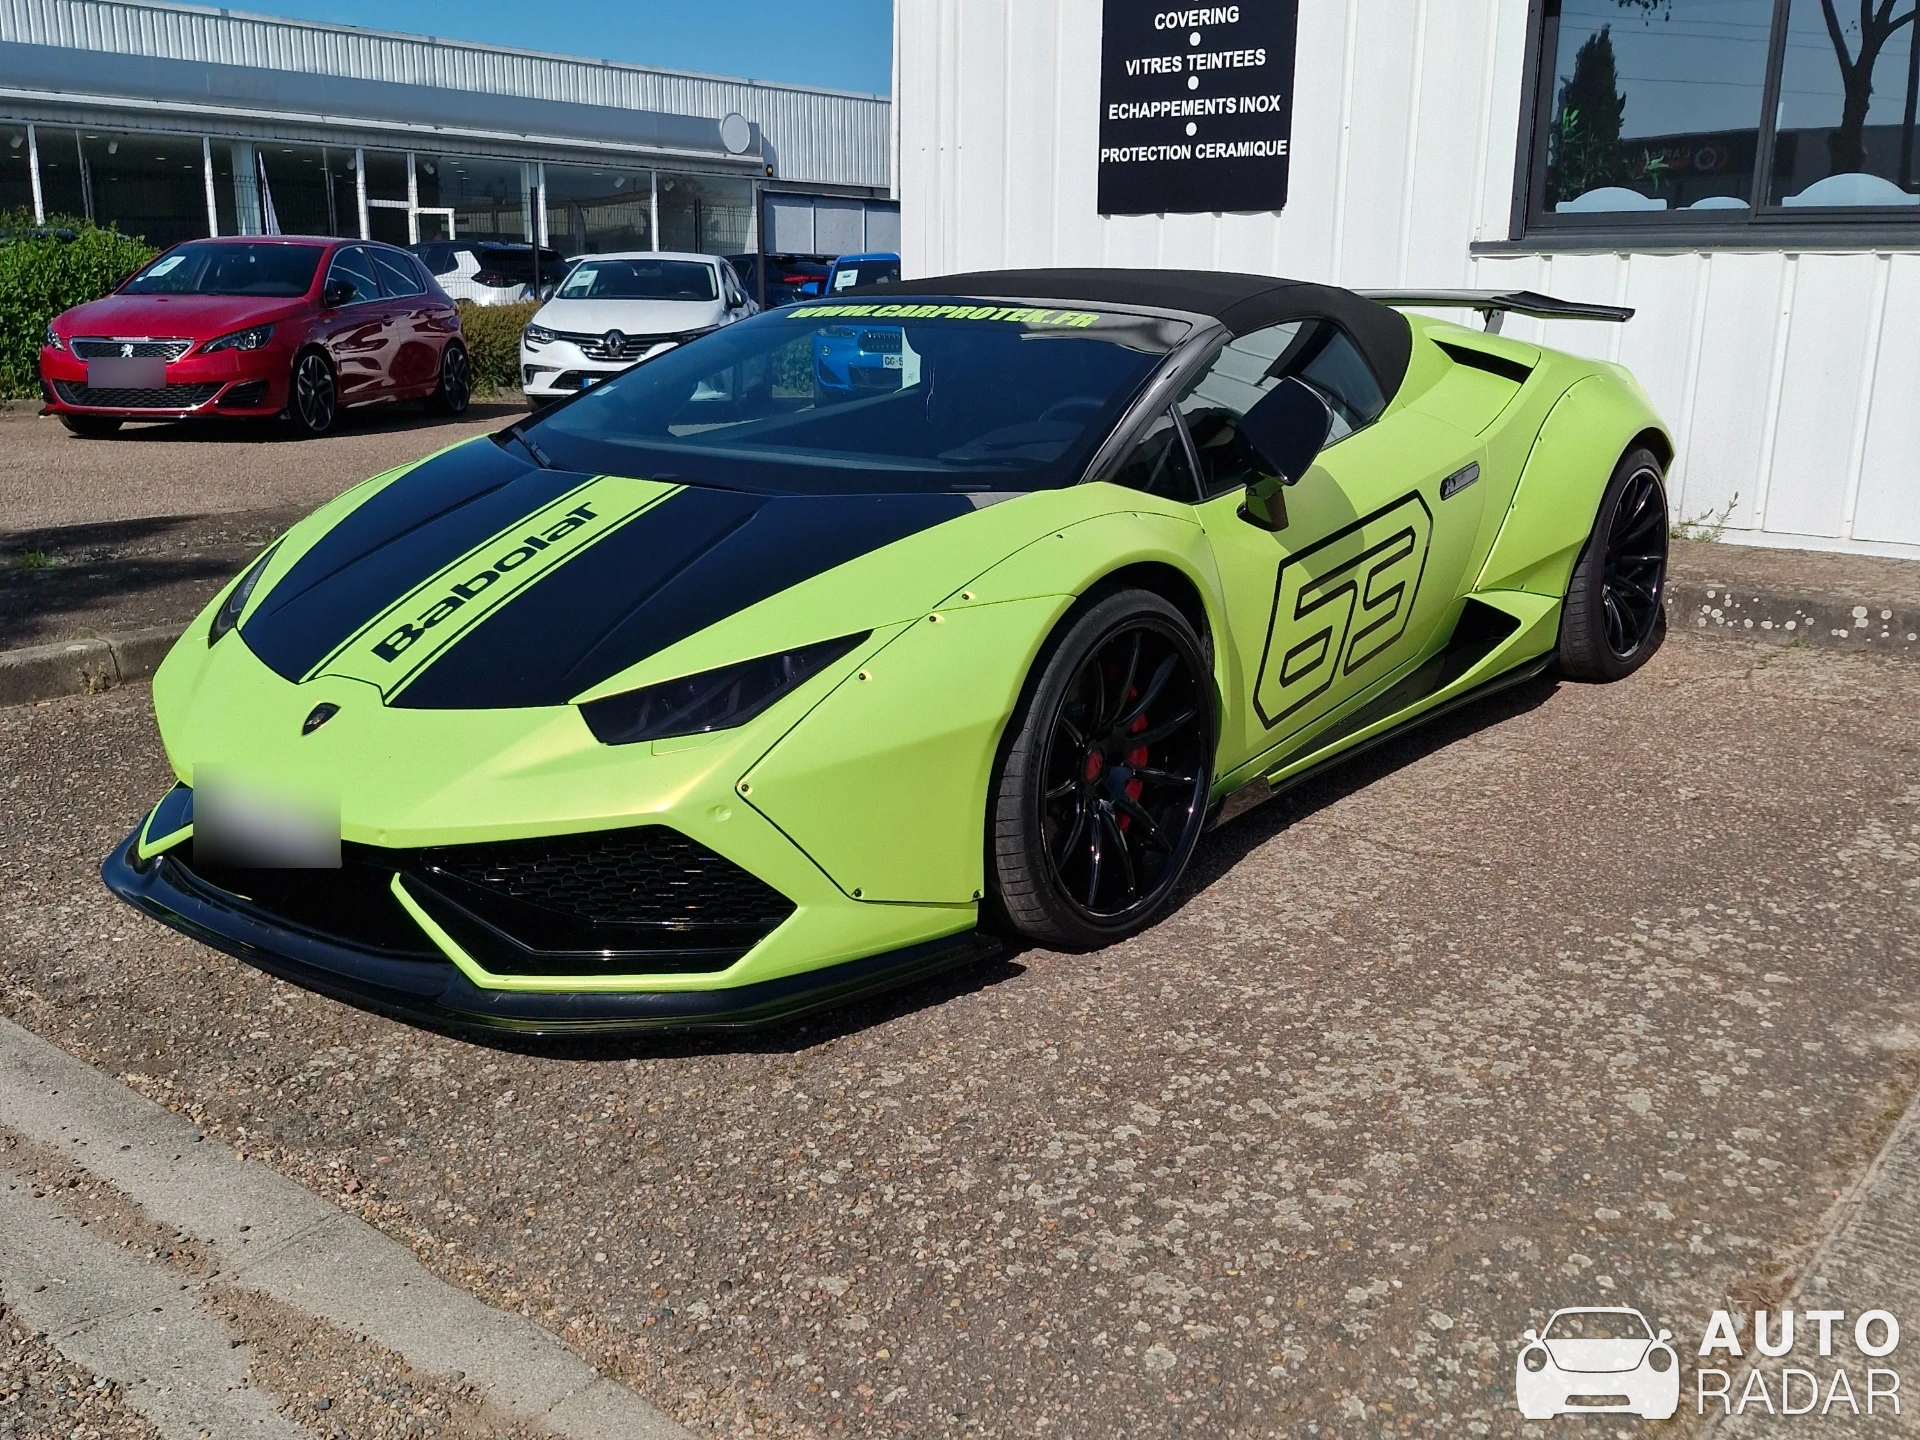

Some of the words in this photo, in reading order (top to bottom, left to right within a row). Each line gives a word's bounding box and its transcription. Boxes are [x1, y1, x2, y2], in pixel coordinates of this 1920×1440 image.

[1154, 5, 1240, 30] COVERING
[1126, 55, 1182, 76] VITRES
[1187, 48, 1266, 71] TEINTEES
[1108, 97, 1236, 119] ECHAPPEMENTS
[1239, 94, 1281, 114] INOX
[1101, 144, 1191, 163] PROTECTION
[1195, 140, 1288, 159] CERAMIQUE
[371, 501, 598, 663] Babolat
